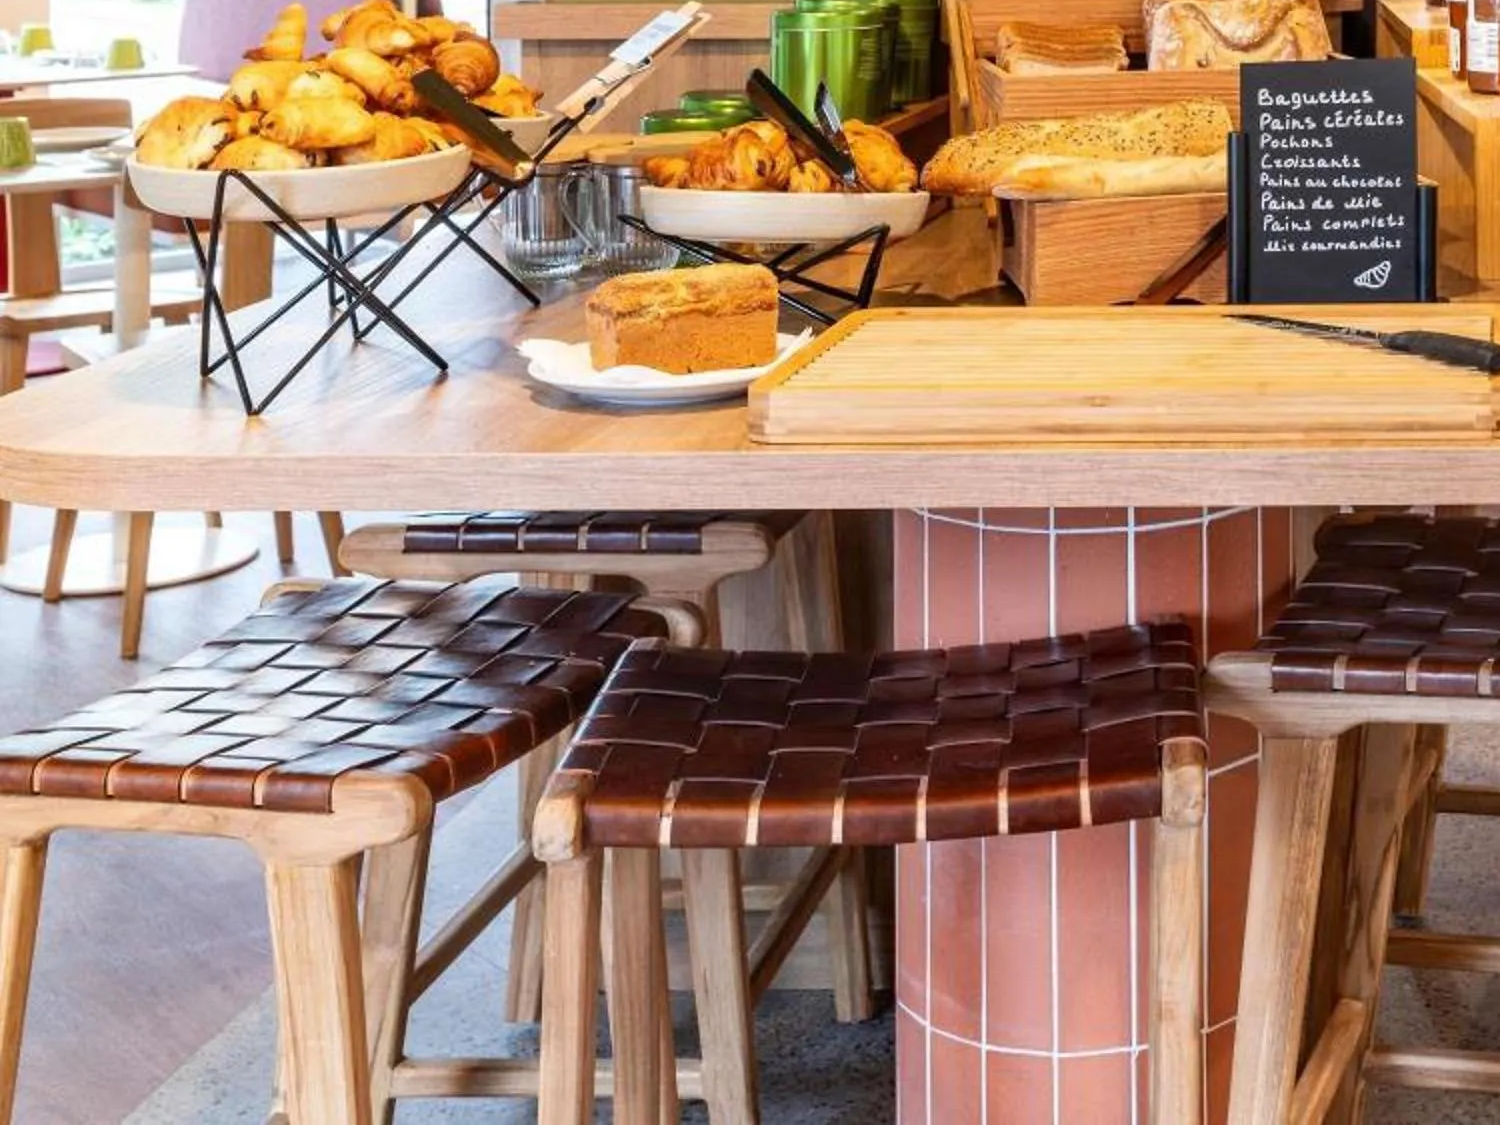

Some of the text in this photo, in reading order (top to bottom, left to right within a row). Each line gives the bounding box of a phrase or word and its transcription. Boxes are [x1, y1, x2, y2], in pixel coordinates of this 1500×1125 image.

[1257, 87, 1374, 110] Baguettes
[1259, 108, 1404, 131] Pains céréales
[1259, 133, 1333, 149] Pochons
[1260, 153, 1361, 169] Croissants
[1259, 171, 1402, 188] Pains au chocolat
[1261, 192, 1305, 210] Pains
[1311, 195, 1335, 210] de
[1263, 213, 1405, 232] Pains complets
